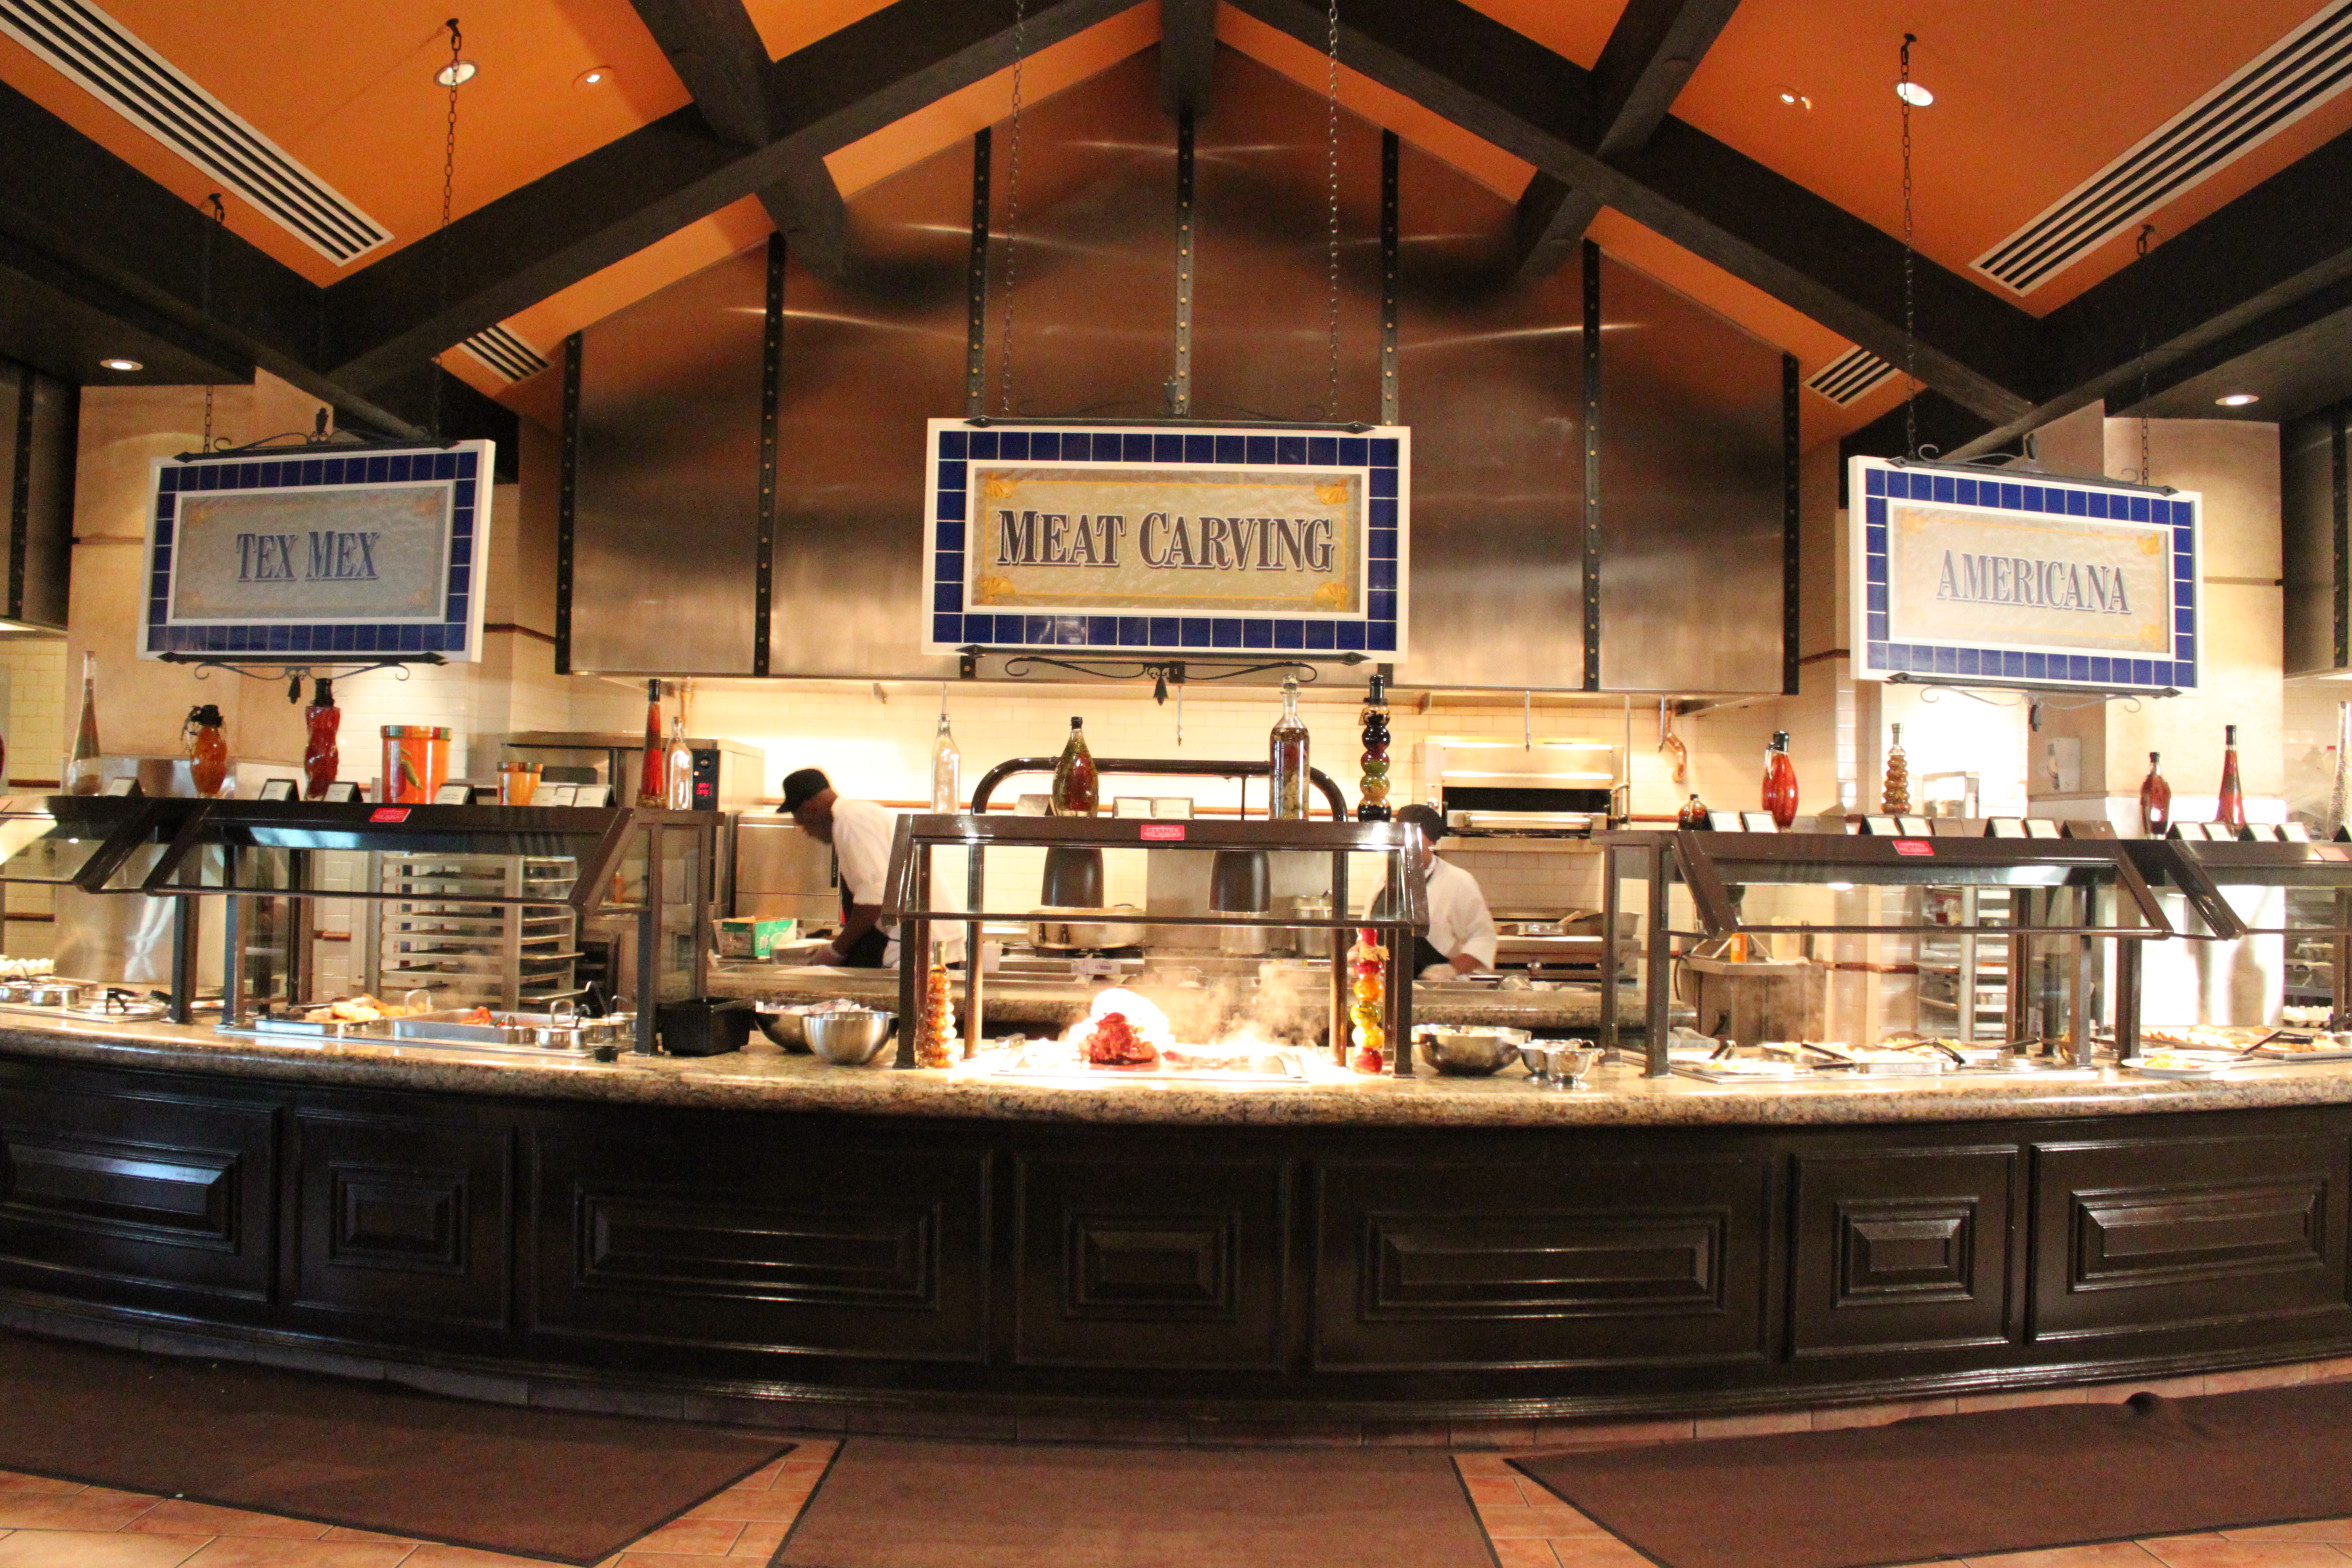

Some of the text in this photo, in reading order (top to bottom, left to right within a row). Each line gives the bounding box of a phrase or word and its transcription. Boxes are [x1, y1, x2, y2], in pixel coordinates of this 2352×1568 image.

[236, 530, 380, 582] TEX MEX
[996, 510, 1335, 572] MEAT CARVING
[1936, 549, 2132, 614] AMERICANA
